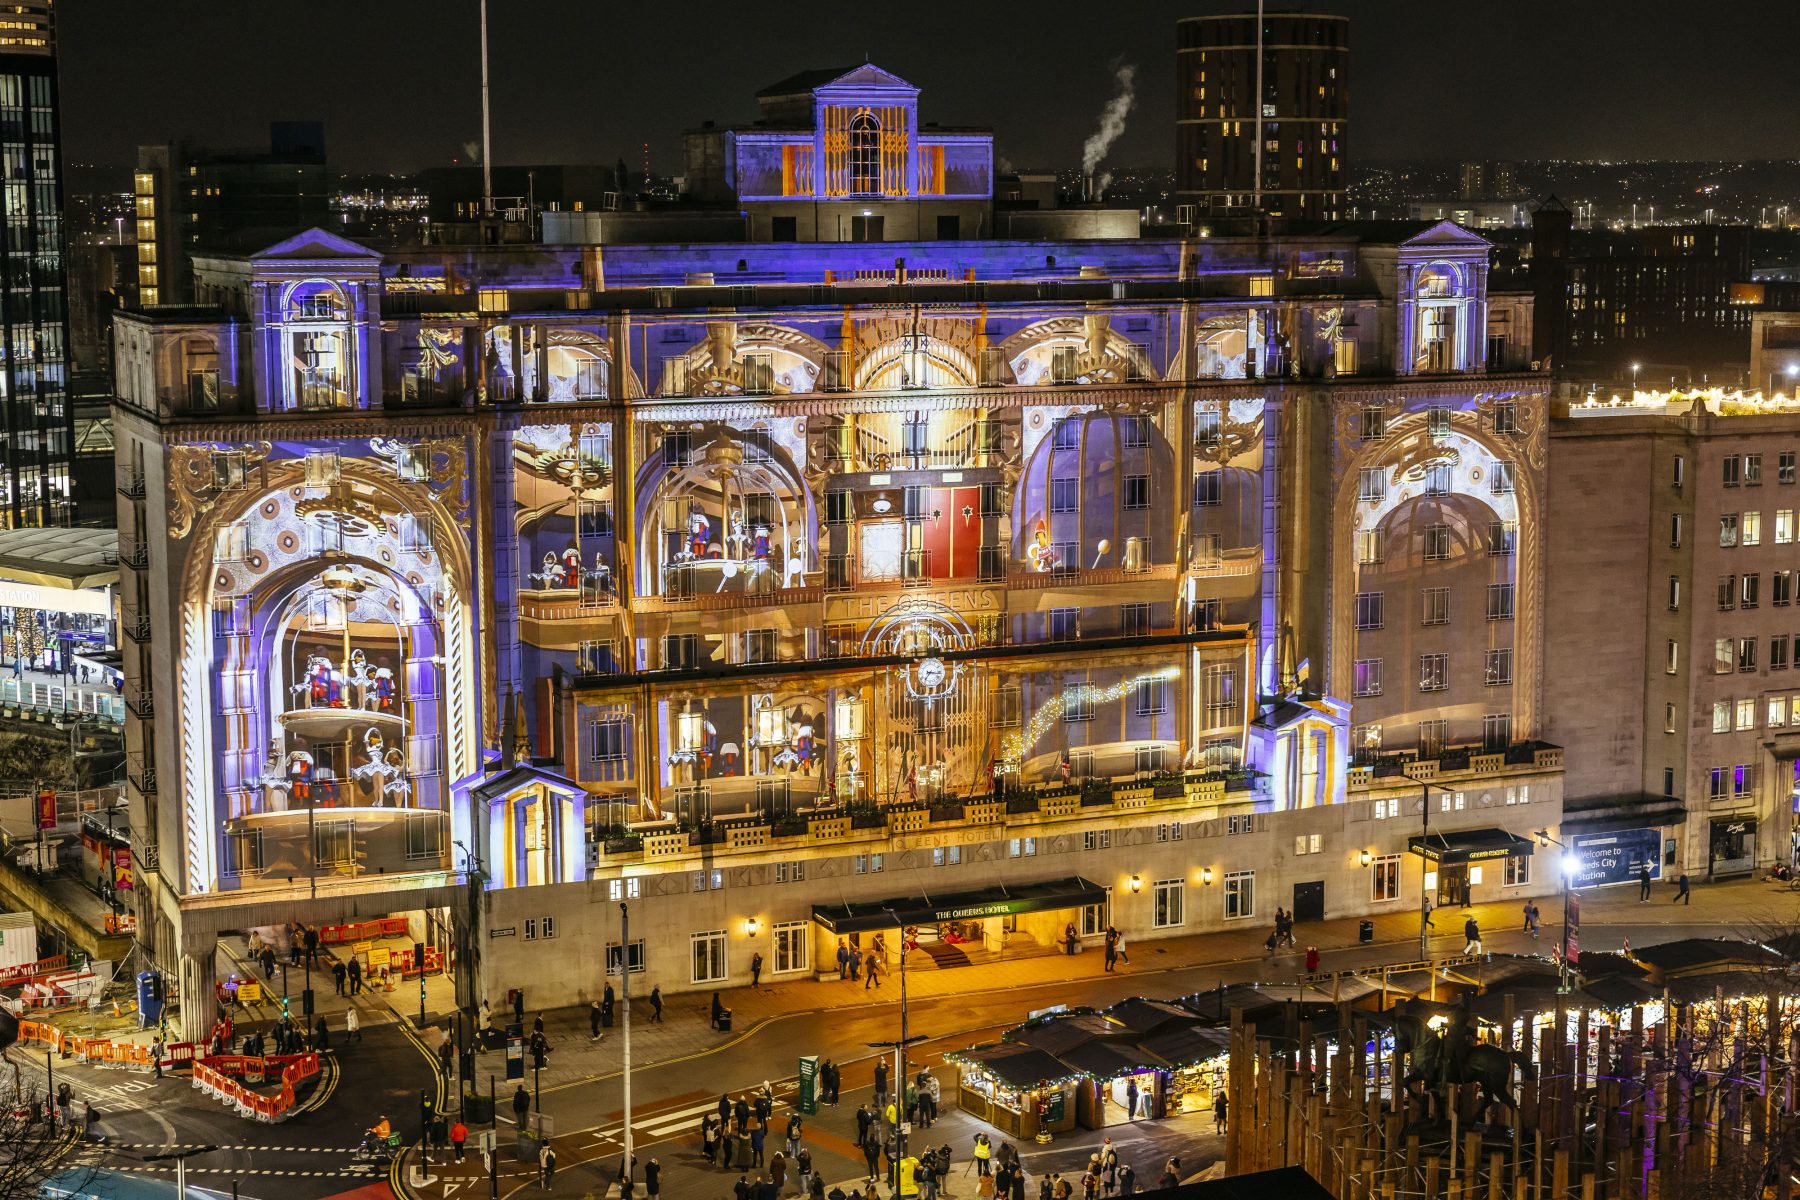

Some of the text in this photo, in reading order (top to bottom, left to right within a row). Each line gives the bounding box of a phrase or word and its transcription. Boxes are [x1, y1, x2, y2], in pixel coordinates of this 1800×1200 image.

[0, 590, 40, 602] STATION
[842, 590, 993, 616] THE QUEENS
[957, 828, 1000, 843] HOTEL
[1579, 847, 1622, 859] Welcome to
[1601, 858, 1617, 869] City
[1577, 871, 1606, 881] Station
[935, 904, 1010, 920] THE QUEENS HOTEL
